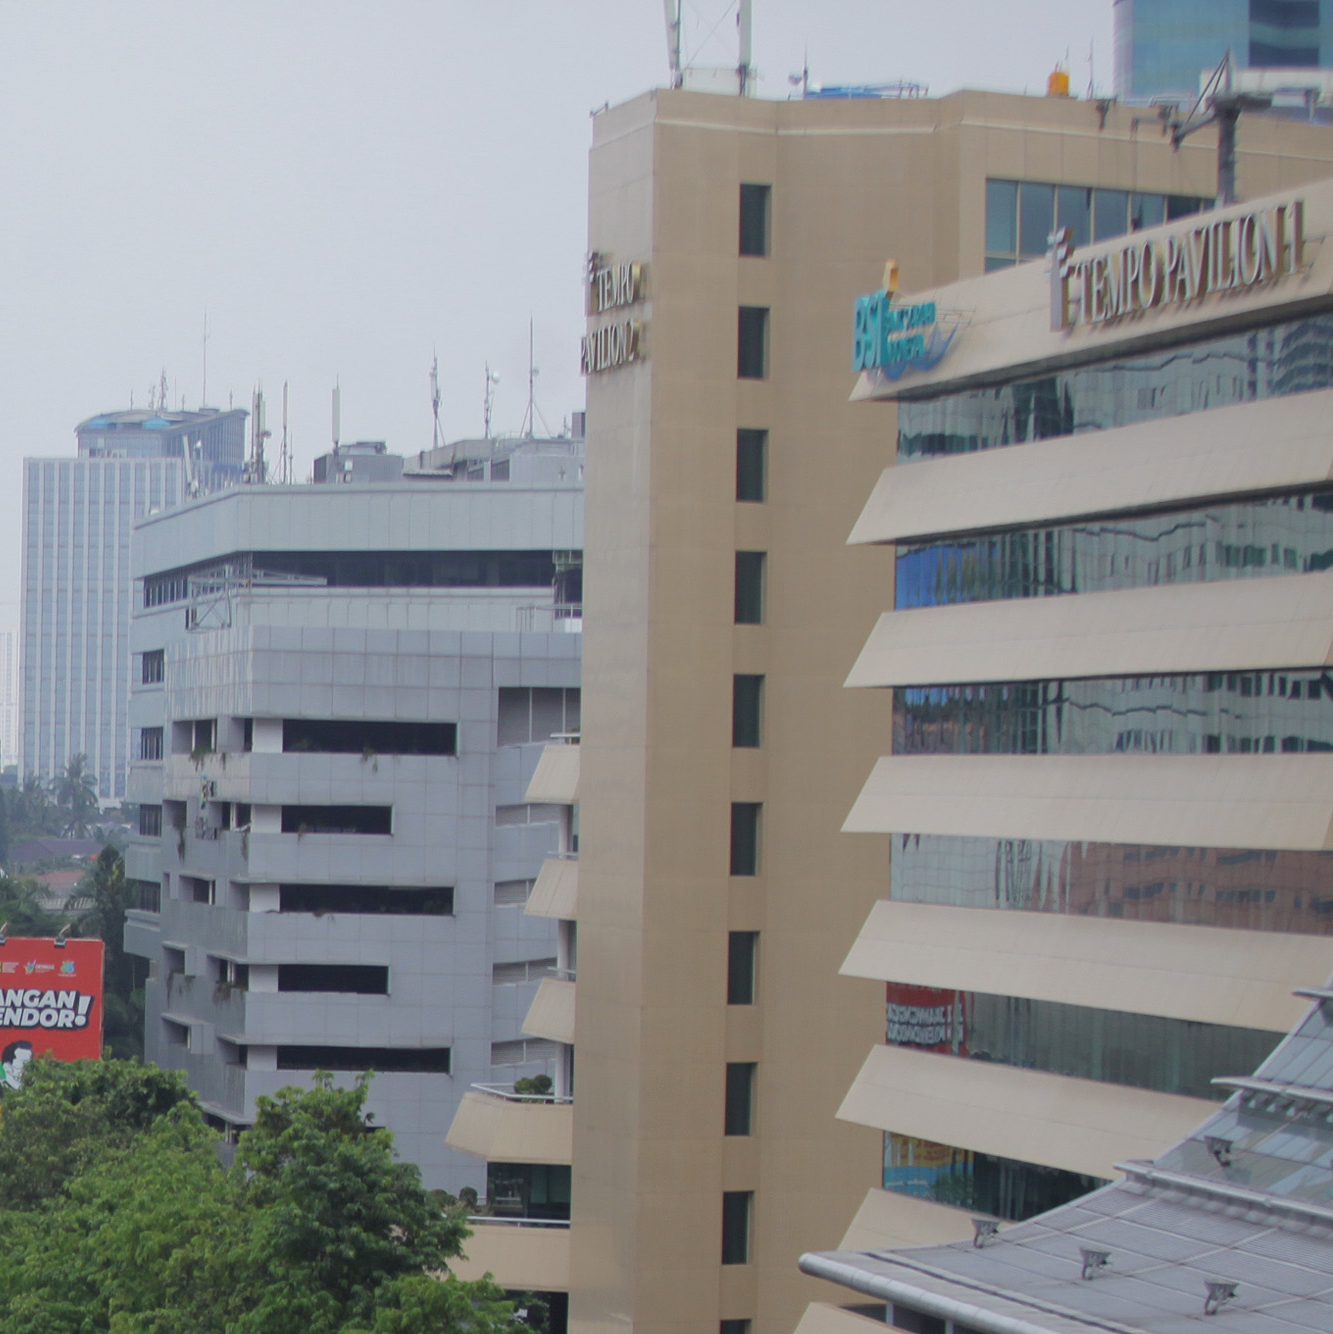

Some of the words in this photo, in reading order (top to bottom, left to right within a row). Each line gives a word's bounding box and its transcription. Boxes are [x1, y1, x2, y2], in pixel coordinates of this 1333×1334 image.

[597, 260, 635, 312] TEMPO
[1075, 241, 1161, 324] TEMPO
[1164, 207, 1282, 304] PAVILION
[581, 322, 628, 376] PAVILION
[853, 289, 889, 373] BSI
